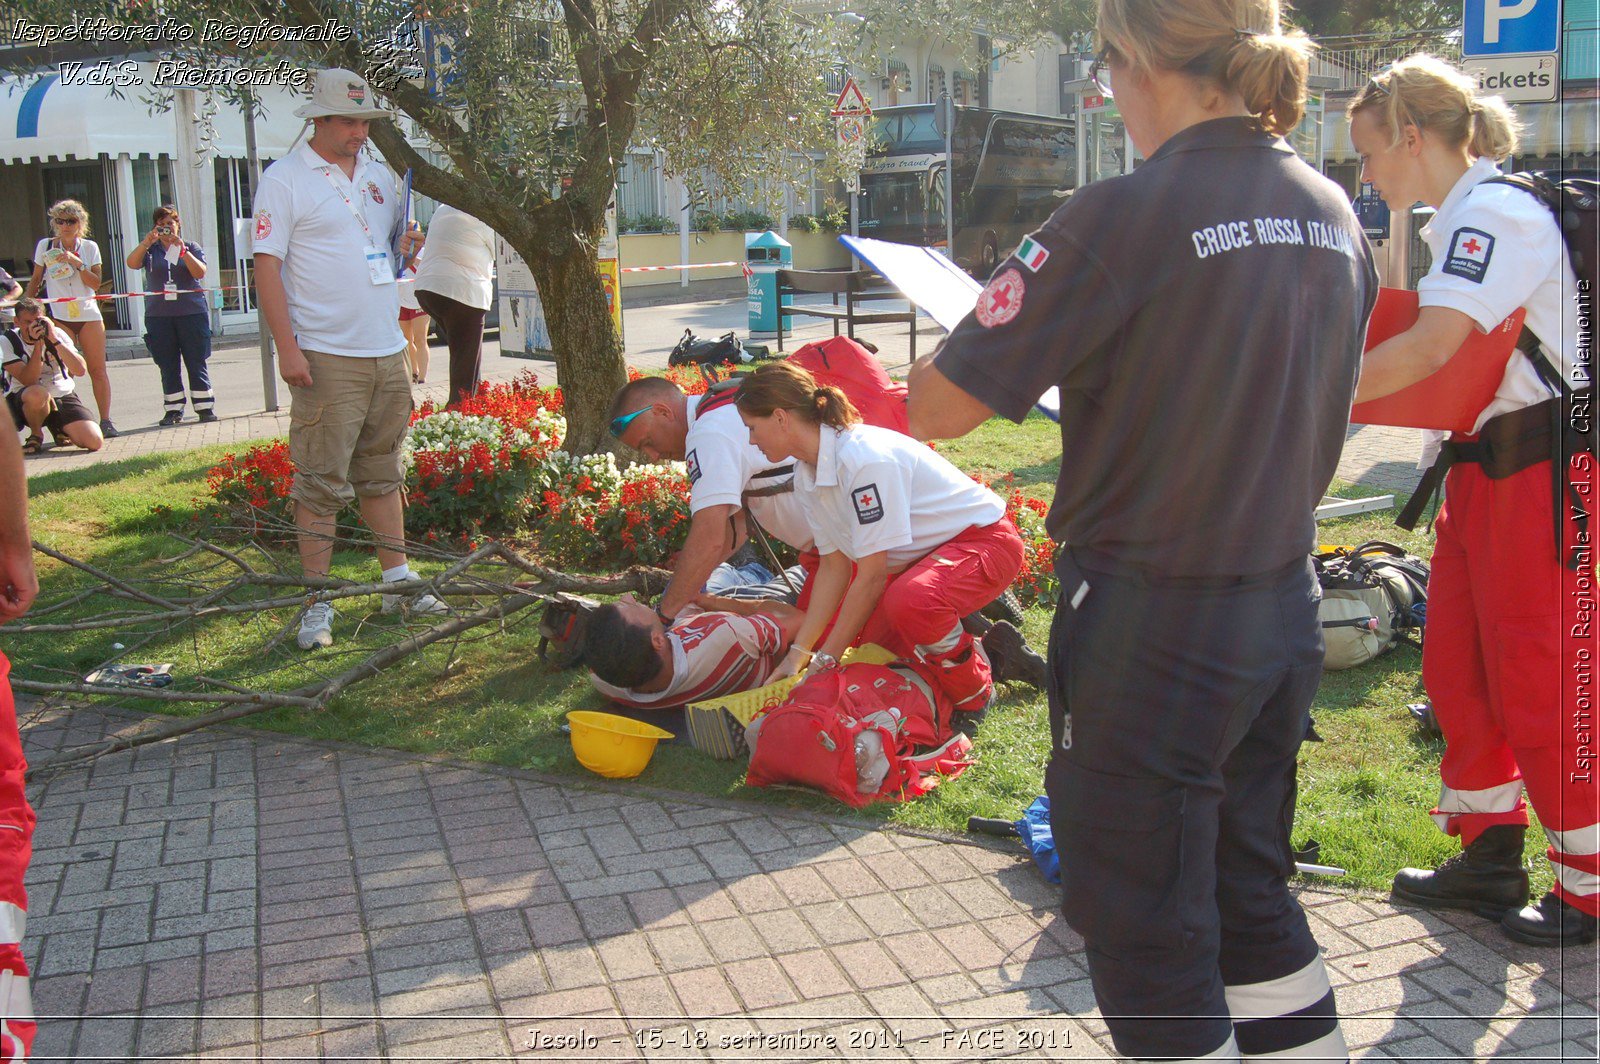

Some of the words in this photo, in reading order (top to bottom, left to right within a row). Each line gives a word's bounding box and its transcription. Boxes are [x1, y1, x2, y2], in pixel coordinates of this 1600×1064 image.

[1483, 0, 1537, 44] P
[1478, 71, 1550, 89] ickets
[898, 157, 930, 168] travel
[1192, 220, 1253, 259] CROCE
[1253, 217, 1304, 246] ROSSA
